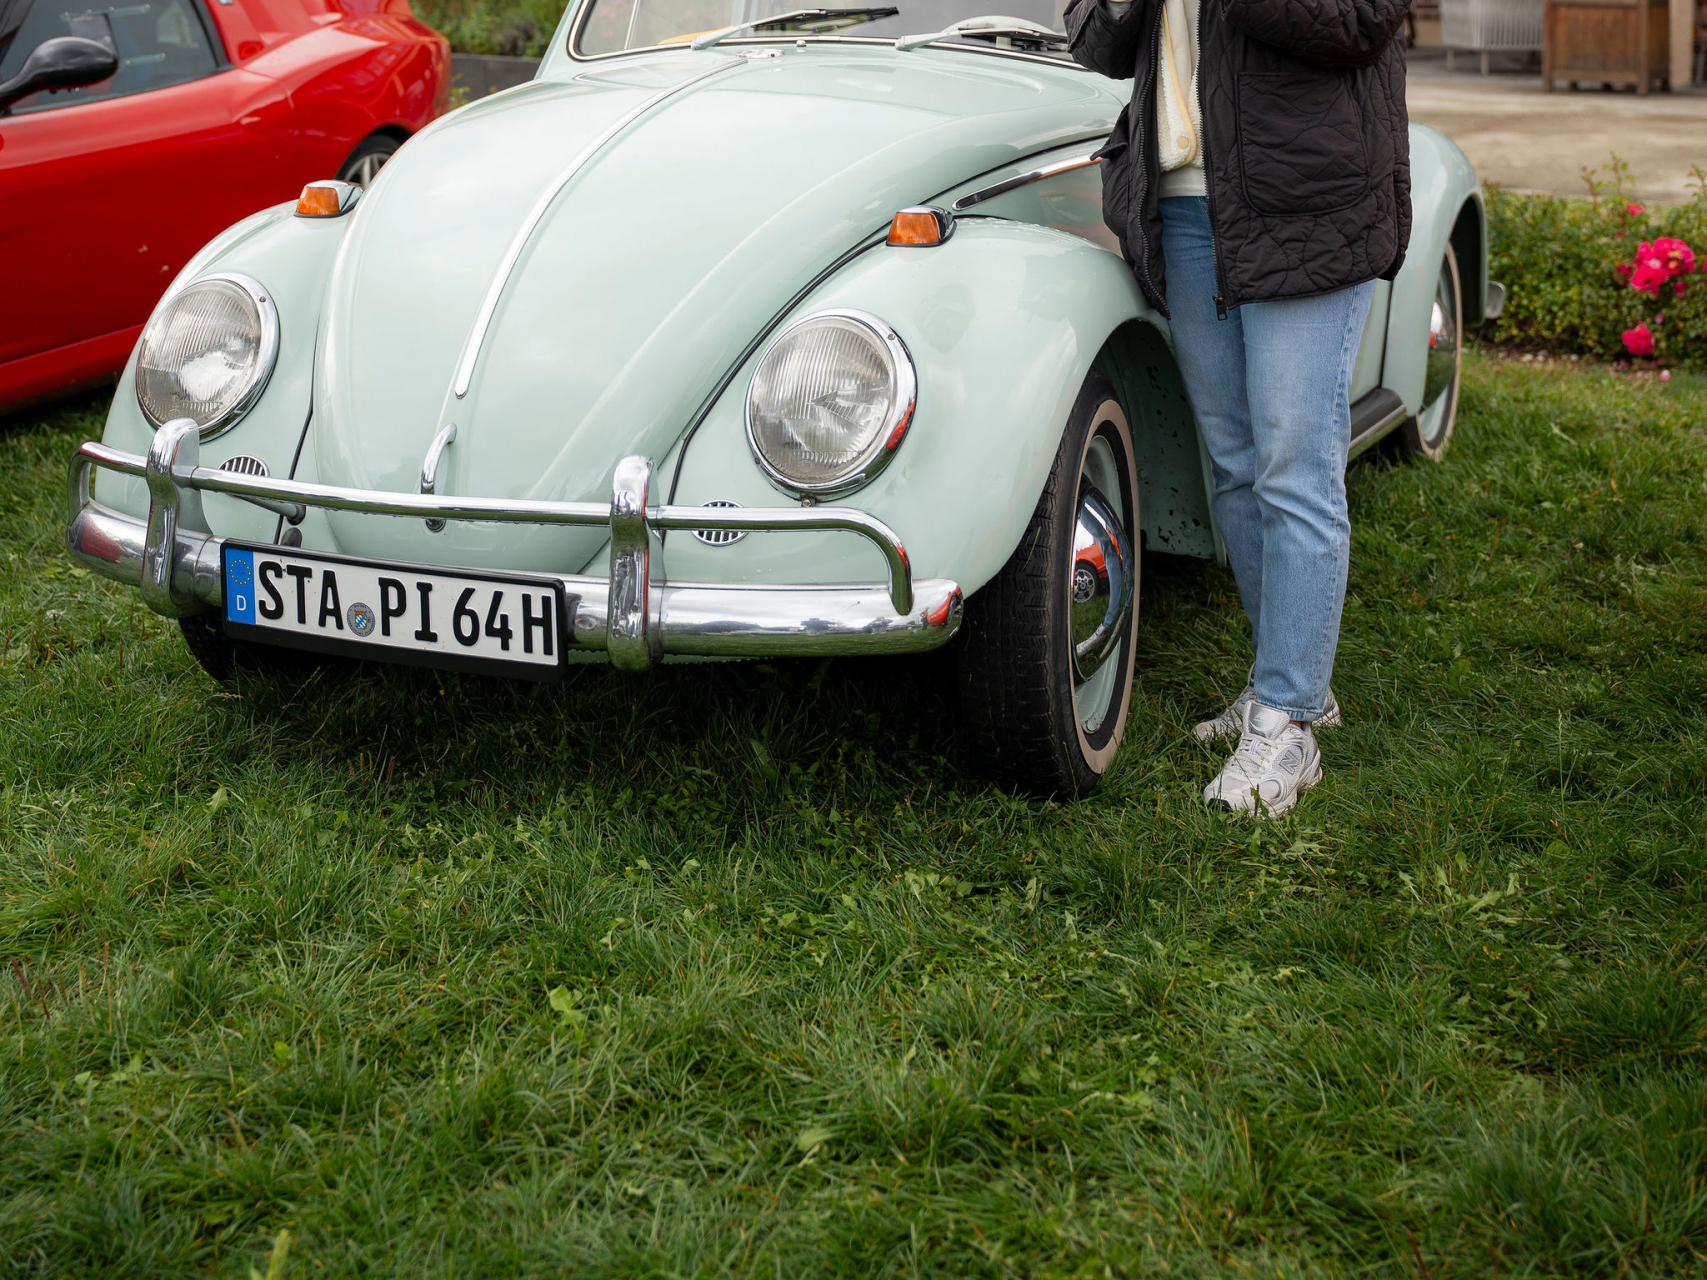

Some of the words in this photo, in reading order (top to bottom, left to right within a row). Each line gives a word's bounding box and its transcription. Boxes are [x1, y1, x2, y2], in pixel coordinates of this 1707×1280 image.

[236, 595, 247, 612] D
[258, 560, 344, 631] STA
[378, 577, 438, 643] PI
[453, 587, 554, 656] 64H
